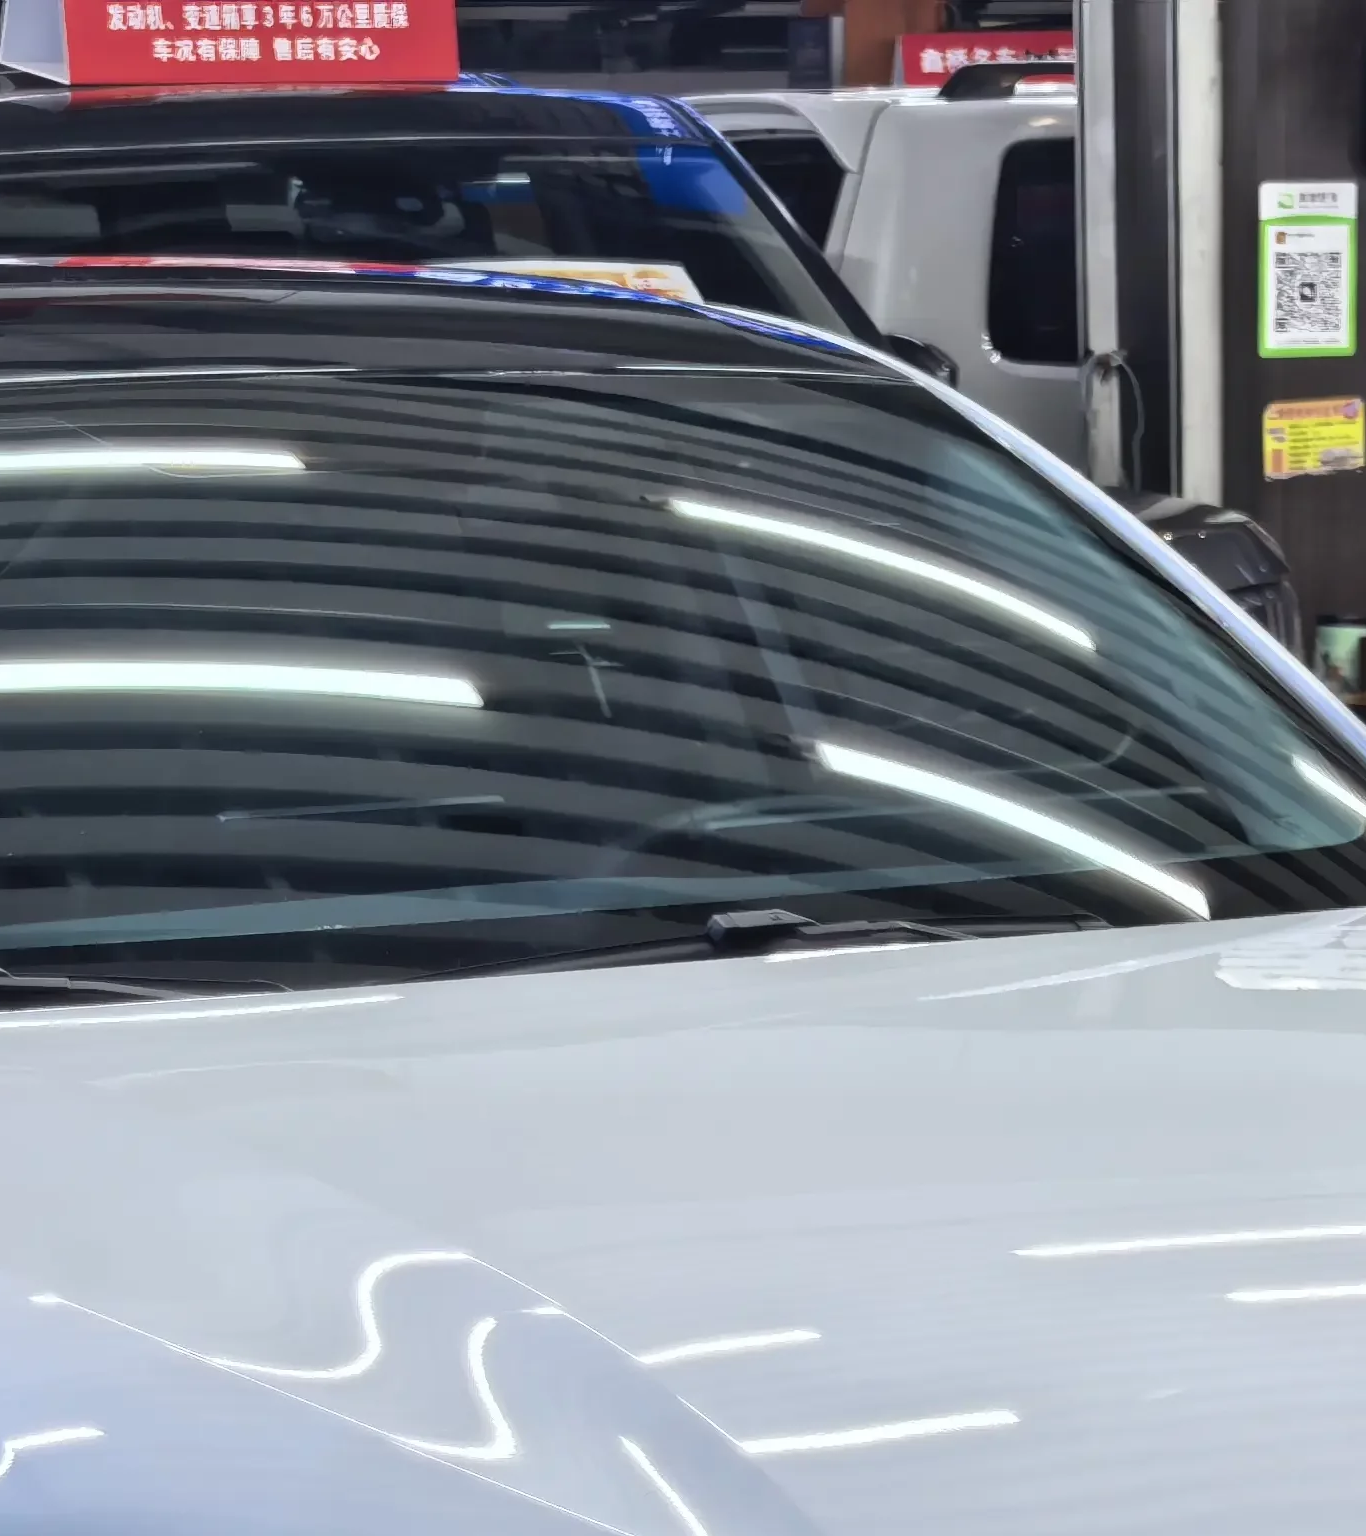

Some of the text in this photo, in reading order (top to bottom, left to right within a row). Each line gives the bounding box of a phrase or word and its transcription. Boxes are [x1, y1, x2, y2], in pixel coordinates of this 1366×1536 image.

[151, 36, 380, 62] 车况有保障 售后有安心
